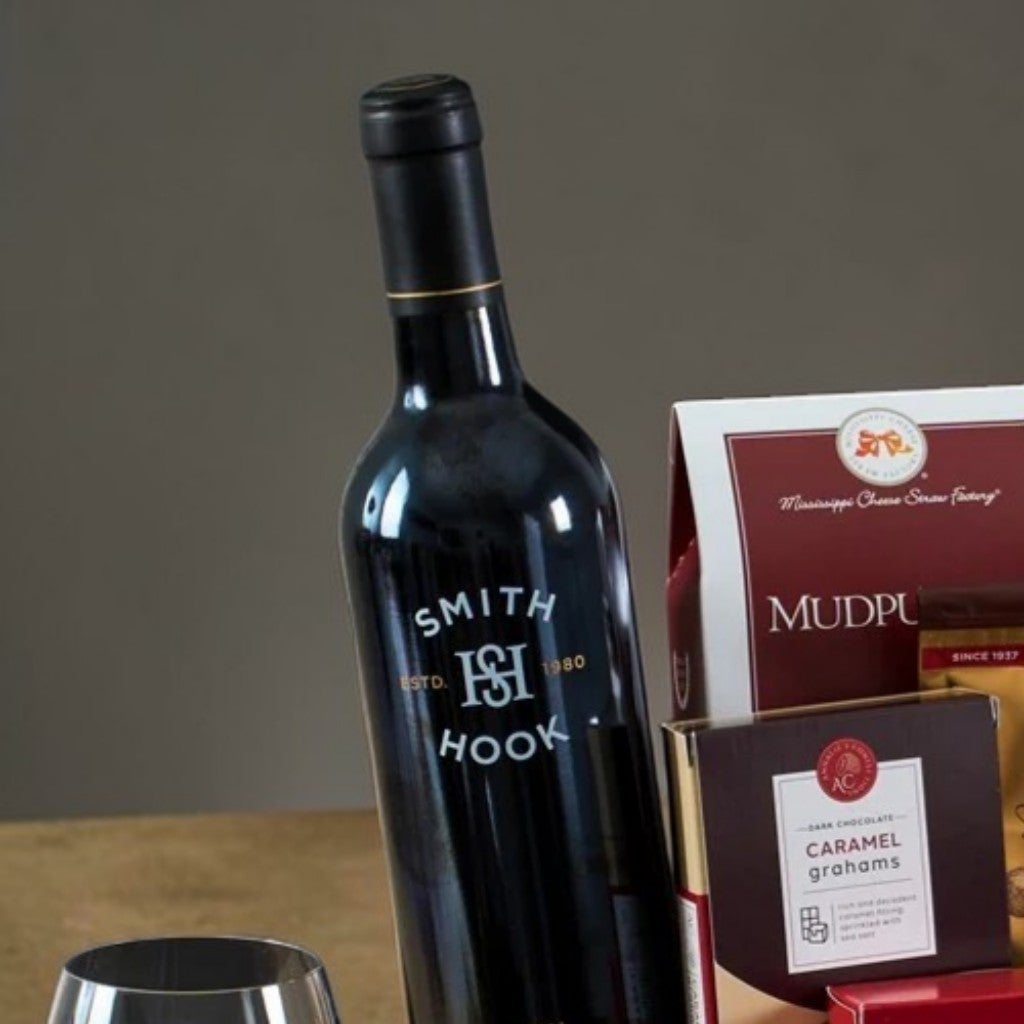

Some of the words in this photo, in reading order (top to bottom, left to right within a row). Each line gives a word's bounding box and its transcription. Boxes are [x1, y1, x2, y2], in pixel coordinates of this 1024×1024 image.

[779, 495, 854, 514] Mississippi
[856, 490, 901, 509] Cheese
[414, 586, 556, 638] SMITH
[541, 654, 586, 676] 1980
[952, 651, 989, 664] SINCE
[991, 650, 1020, 663] 1937
[439, 715, 570, 765] HOOK
[808, 822, 834, 832] DARK
[836, 814, 894, 828] CHOCOLATE
[806, 833, 902, 858] CARAMEL
[808, 856, 901, 883] grahams
